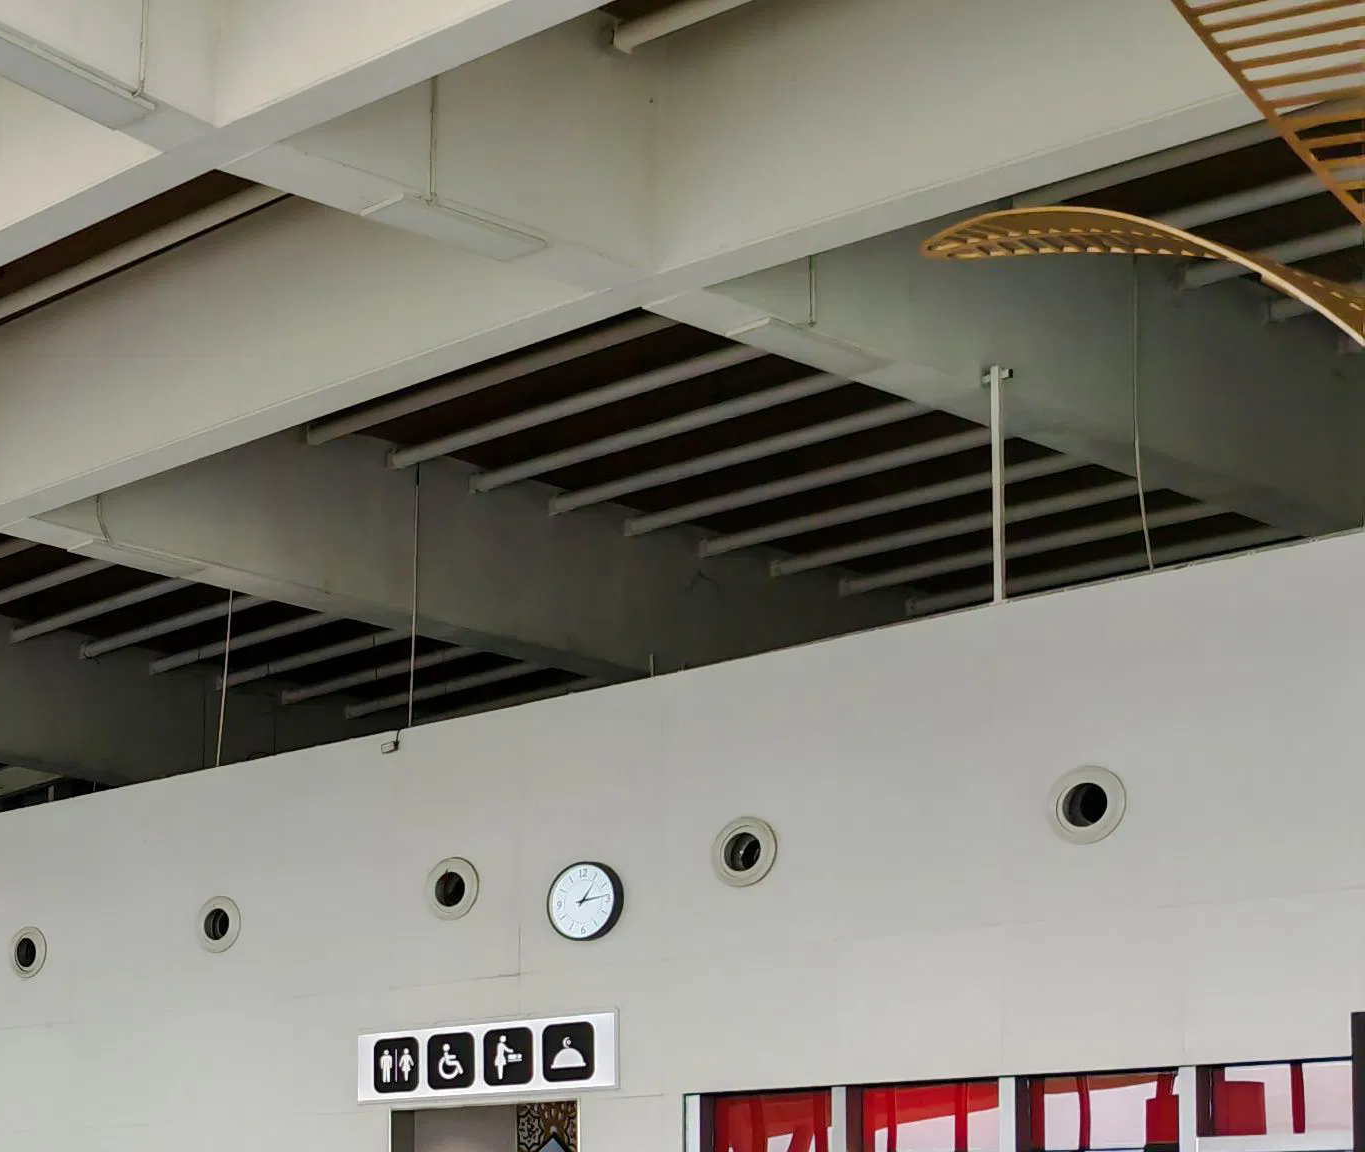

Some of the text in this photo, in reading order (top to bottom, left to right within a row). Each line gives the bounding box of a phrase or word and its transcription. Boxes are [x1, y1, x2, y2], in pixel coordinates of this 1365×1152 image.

[579, 868, 588, 878] 12
[557, 901, 562, 910] 9
[581, 926, 586, 934] 6
